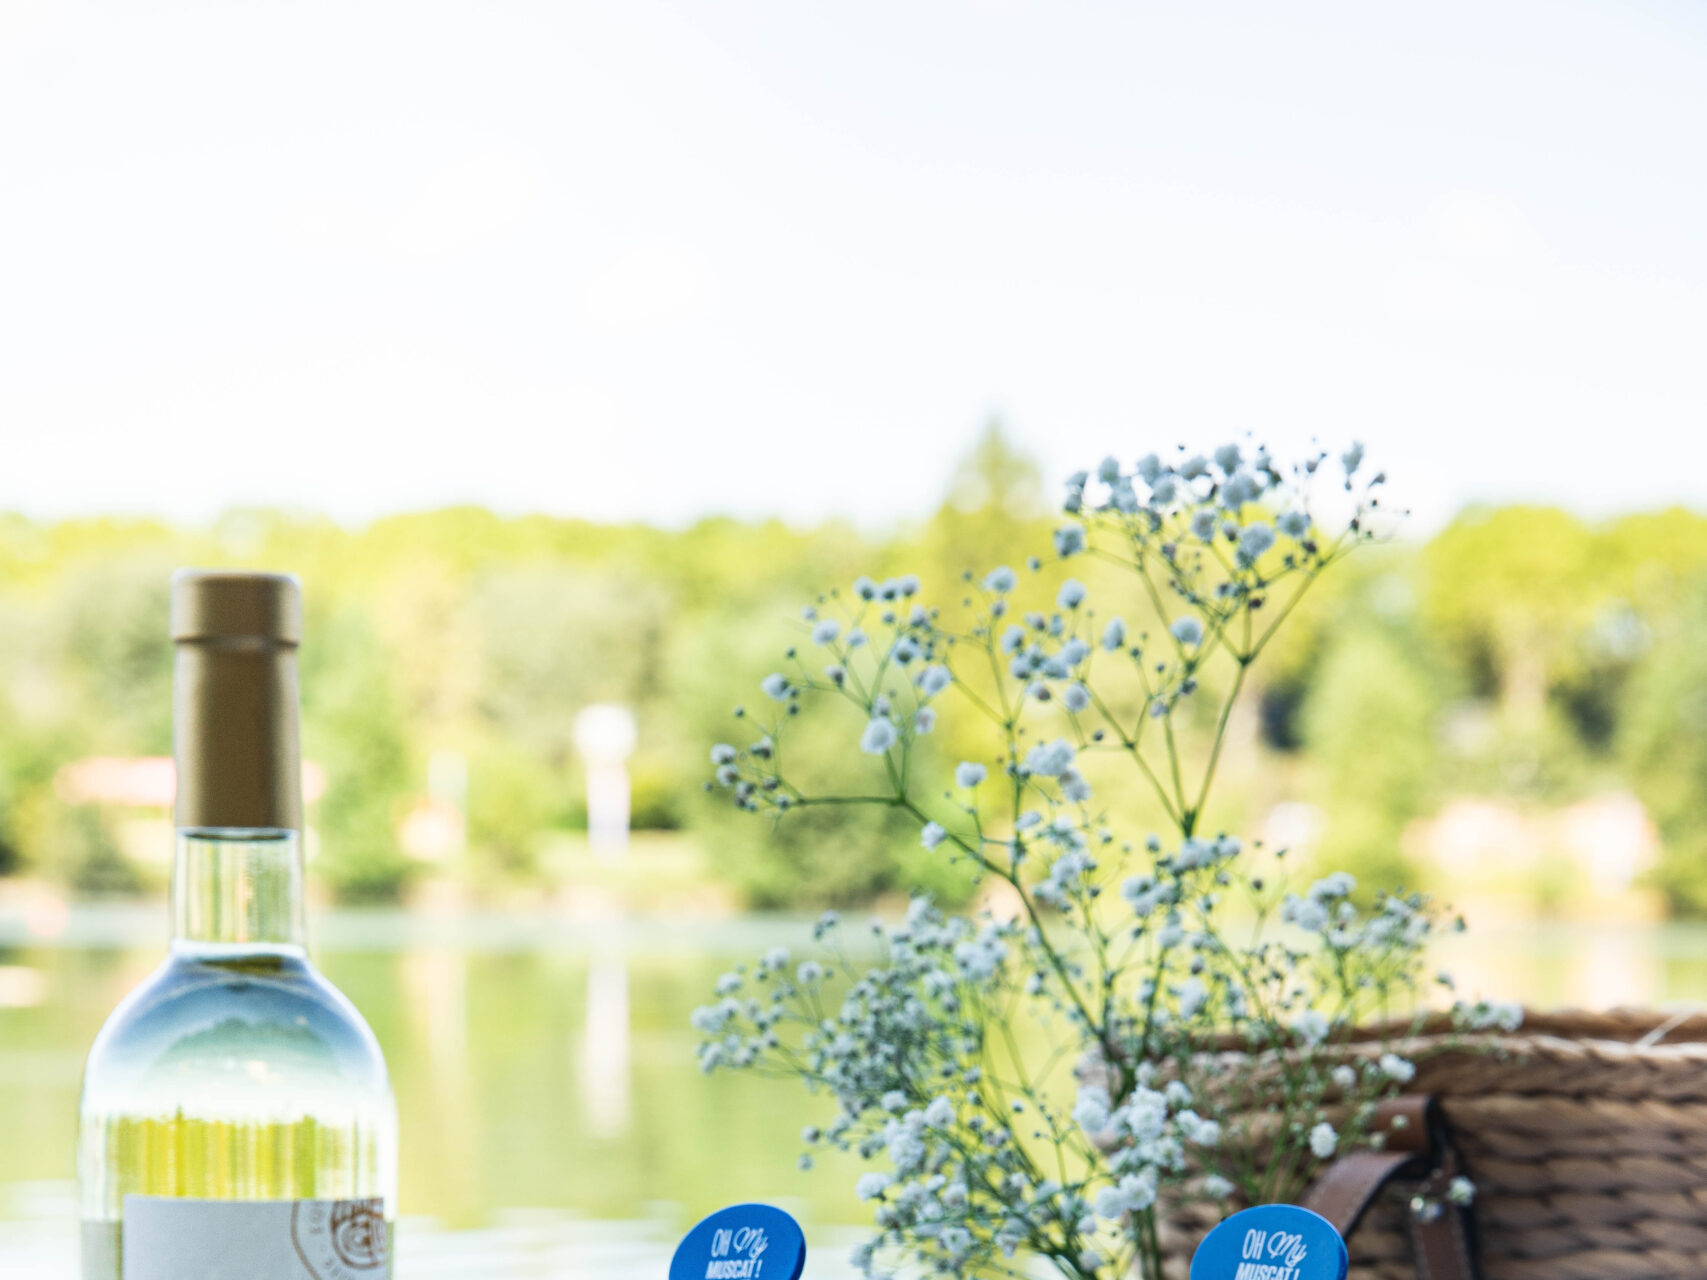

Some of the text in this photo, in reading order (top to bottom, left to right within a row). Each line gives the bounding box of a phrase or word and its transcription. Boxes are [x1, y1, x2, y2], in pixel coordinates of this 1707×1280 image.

[711, 1226, 768, 1260] OH My
[1242, 1228, 1308, 1268] OH My
